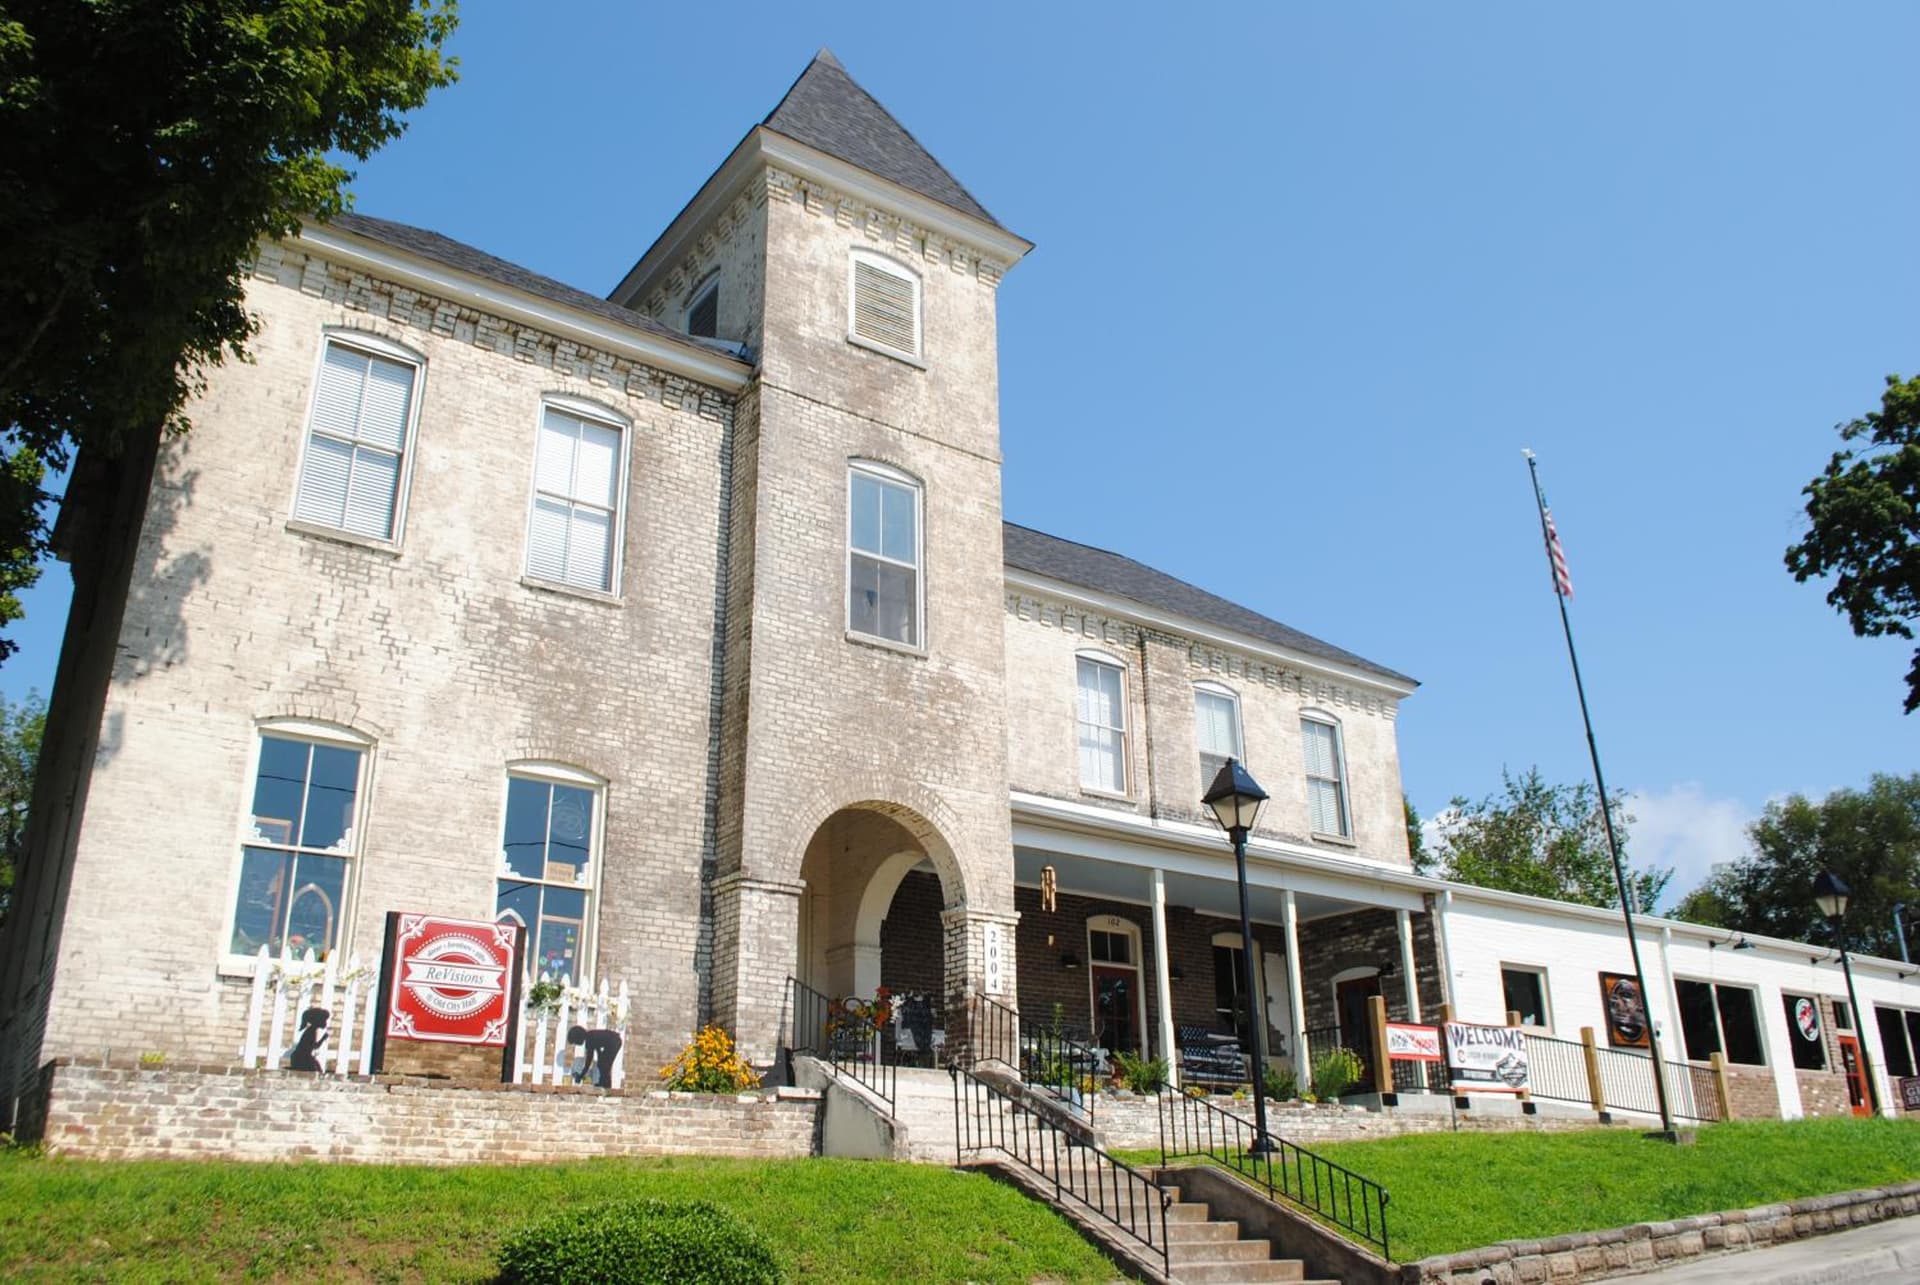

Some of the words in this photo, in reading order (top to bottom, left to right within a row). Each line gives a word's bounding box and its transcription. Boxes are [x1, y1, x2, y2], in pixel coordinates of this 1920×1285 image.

[990, 930, 998, 990] 2004
[426, 966, 484, 984] ReVisions
[433, 998, 445, 1008] Old
[446, 1001, 461, 1011] City
[462, 997, 478, 1008] Hall
[1448, 1024, 1527, 1052] WELCOME
